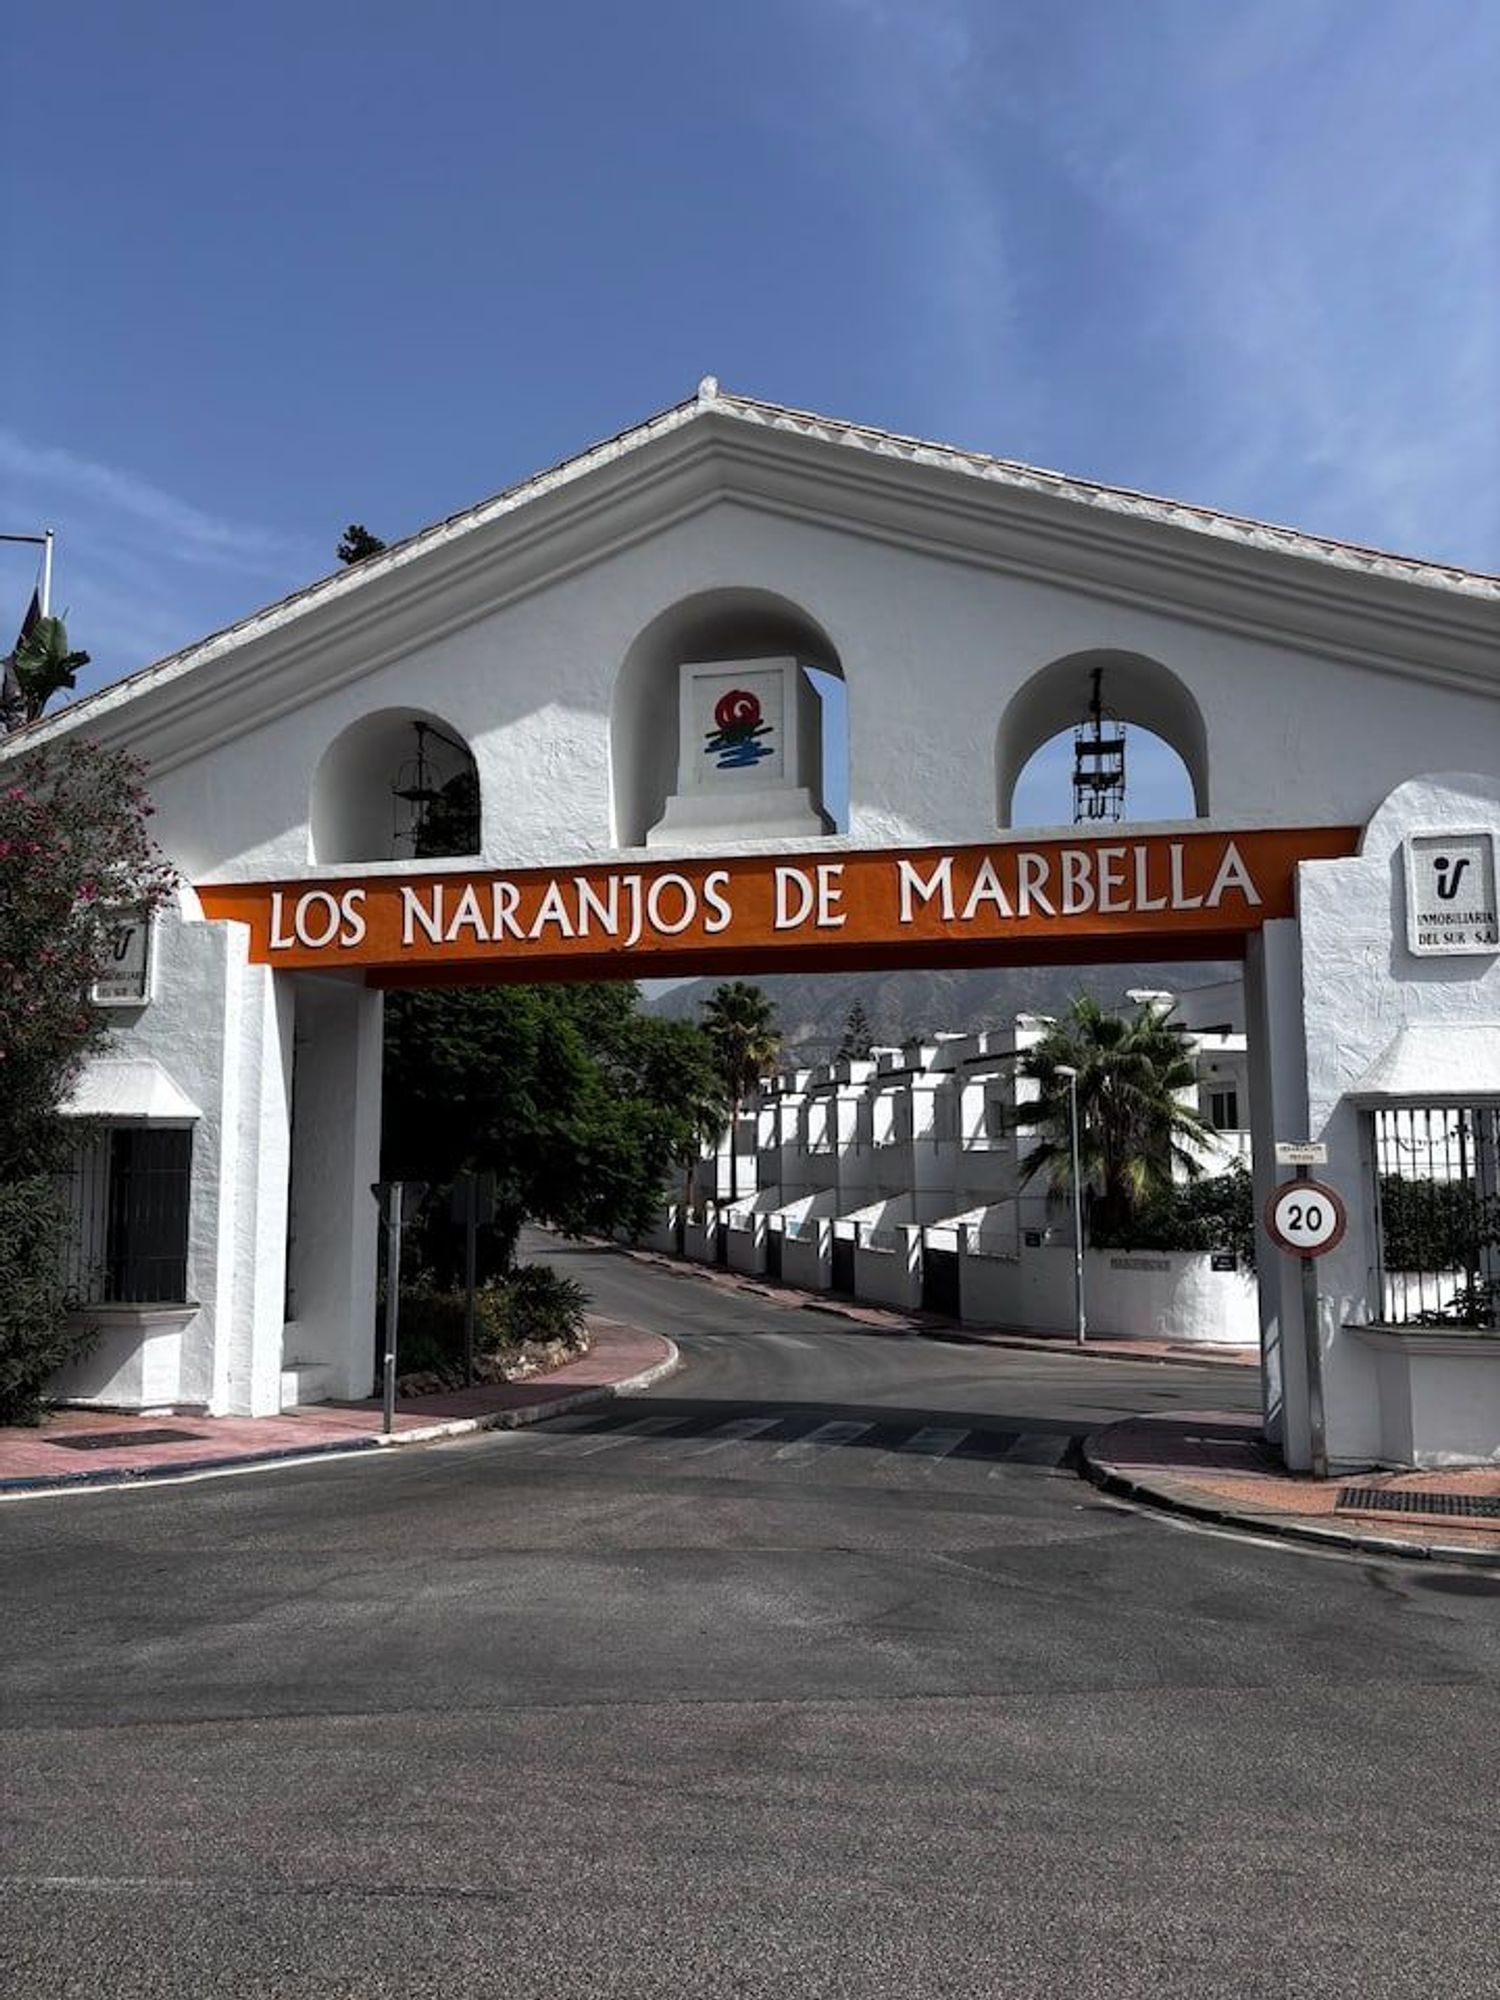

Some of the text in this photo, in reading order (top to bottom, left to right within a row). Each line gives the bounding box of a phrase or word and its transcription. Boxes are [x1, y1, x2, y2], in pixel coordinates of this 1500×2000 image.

[270, 841, 1263, 950] LOS NARANJOS DE MARBELLA
[1418, 933, 1440, 945] DEL
[1288, 1205, 1322, 1232] 20
